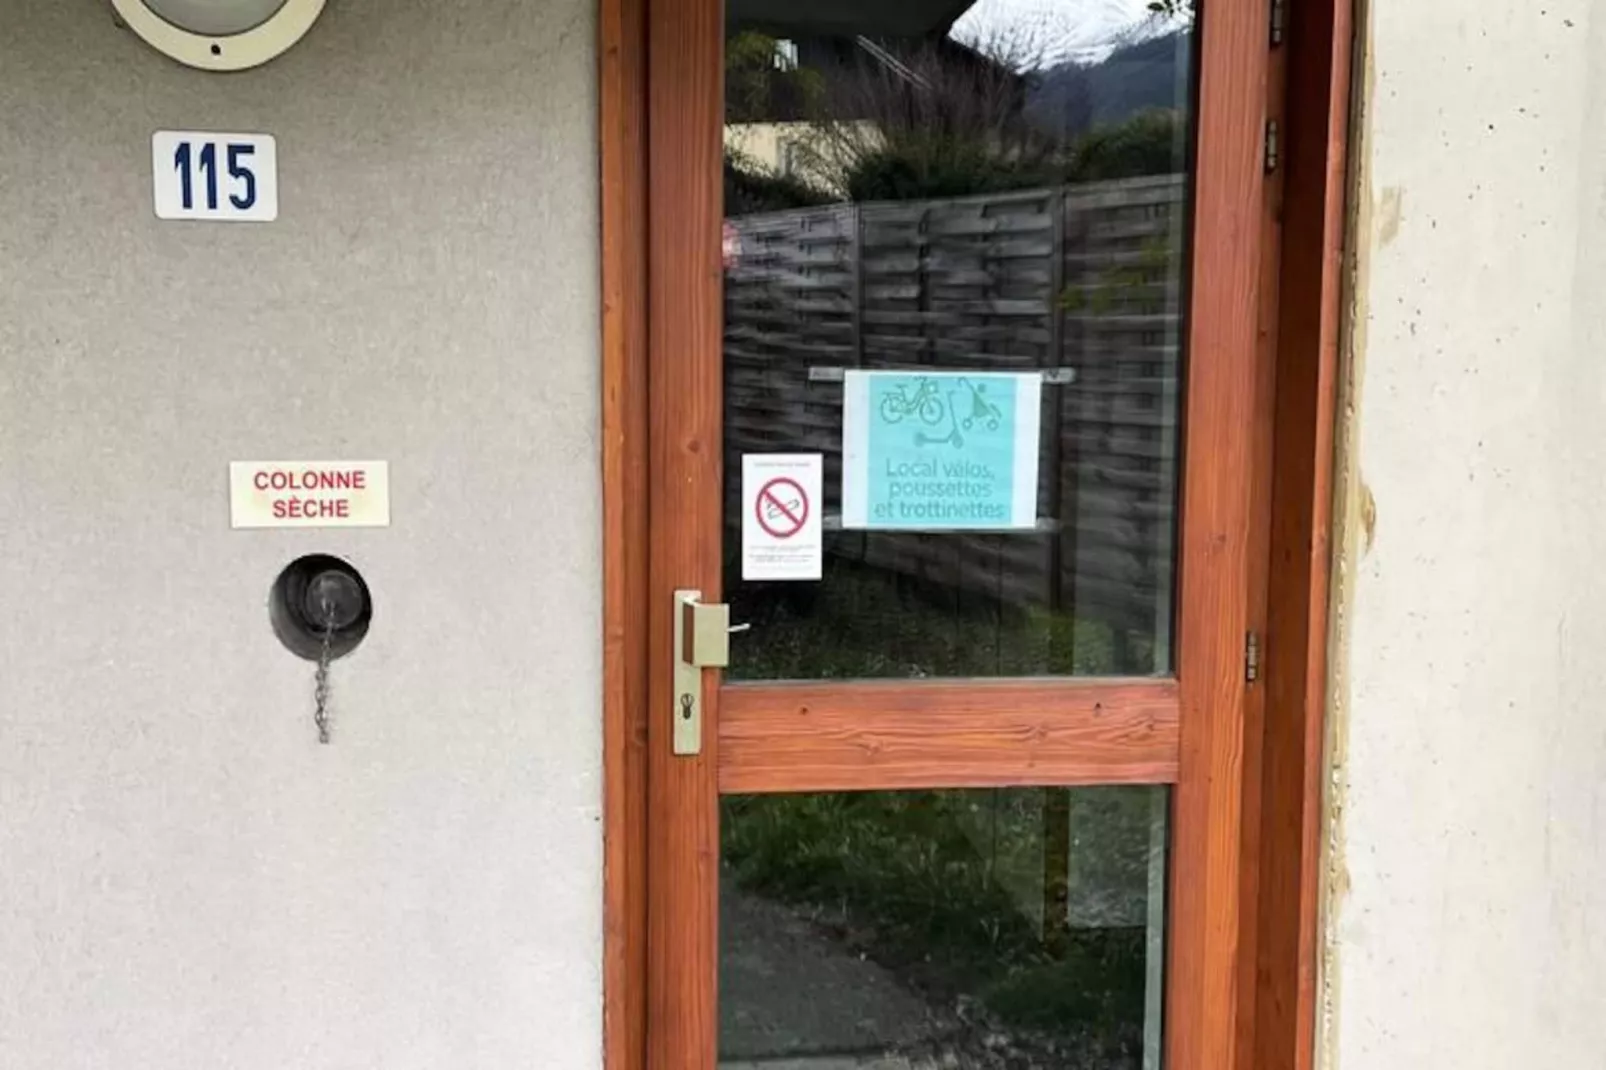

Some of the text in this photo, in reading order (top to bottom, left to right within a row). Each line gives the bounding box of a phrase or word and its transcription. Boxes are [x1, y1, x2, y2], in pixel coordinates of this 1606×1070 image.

[174, 142, 256, 210] 115
[885, 457, 938, 478] Local
[254, 471, 366, 490] COLONNE
[889, 480, 994, 499] poussettes
[272, 495, 350, 518] SÈCHE
[873, 500, 1006, 519] et trottinettes
